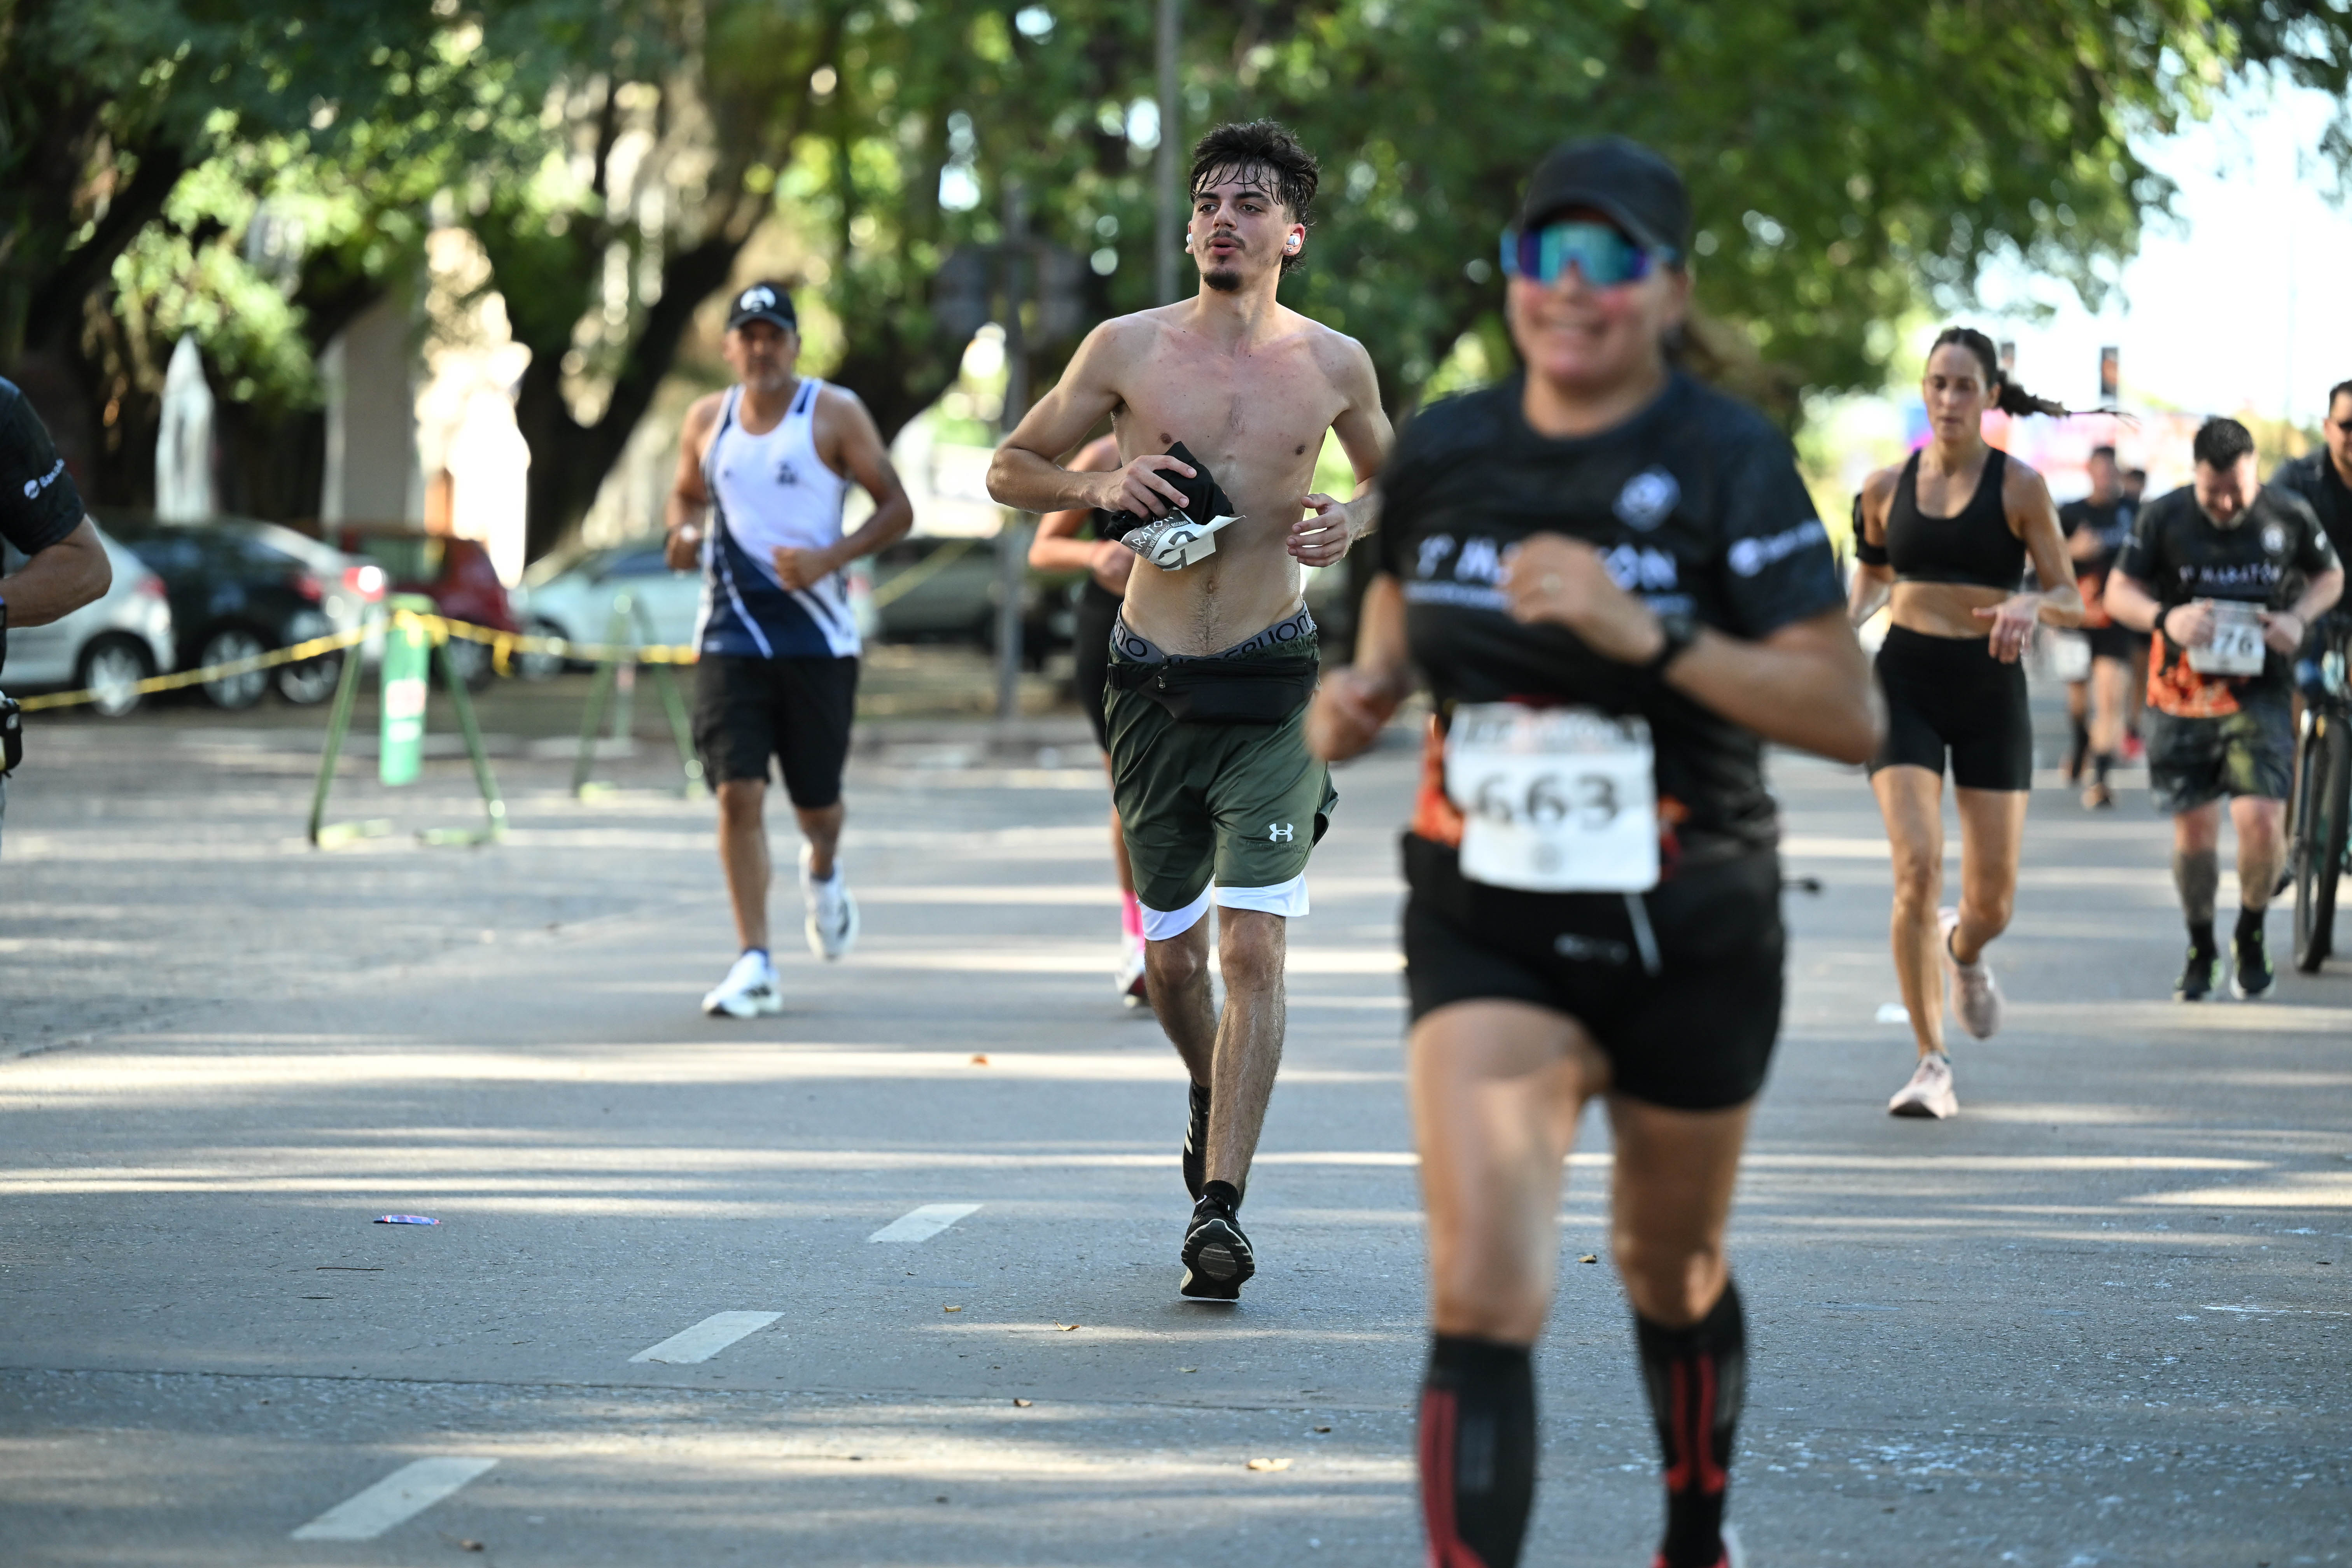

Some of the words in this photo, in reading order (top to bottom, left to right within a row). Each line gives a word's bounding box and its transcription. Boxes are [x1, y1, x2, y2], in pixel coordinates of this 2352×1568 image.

[1130, 516, 1174, 553] ARATO
[1148, 524, 1172, 548] VOLUNTARIOS
[2207, 629, 2255, 658] 76
[1475, 774, 1619, 831] 663
